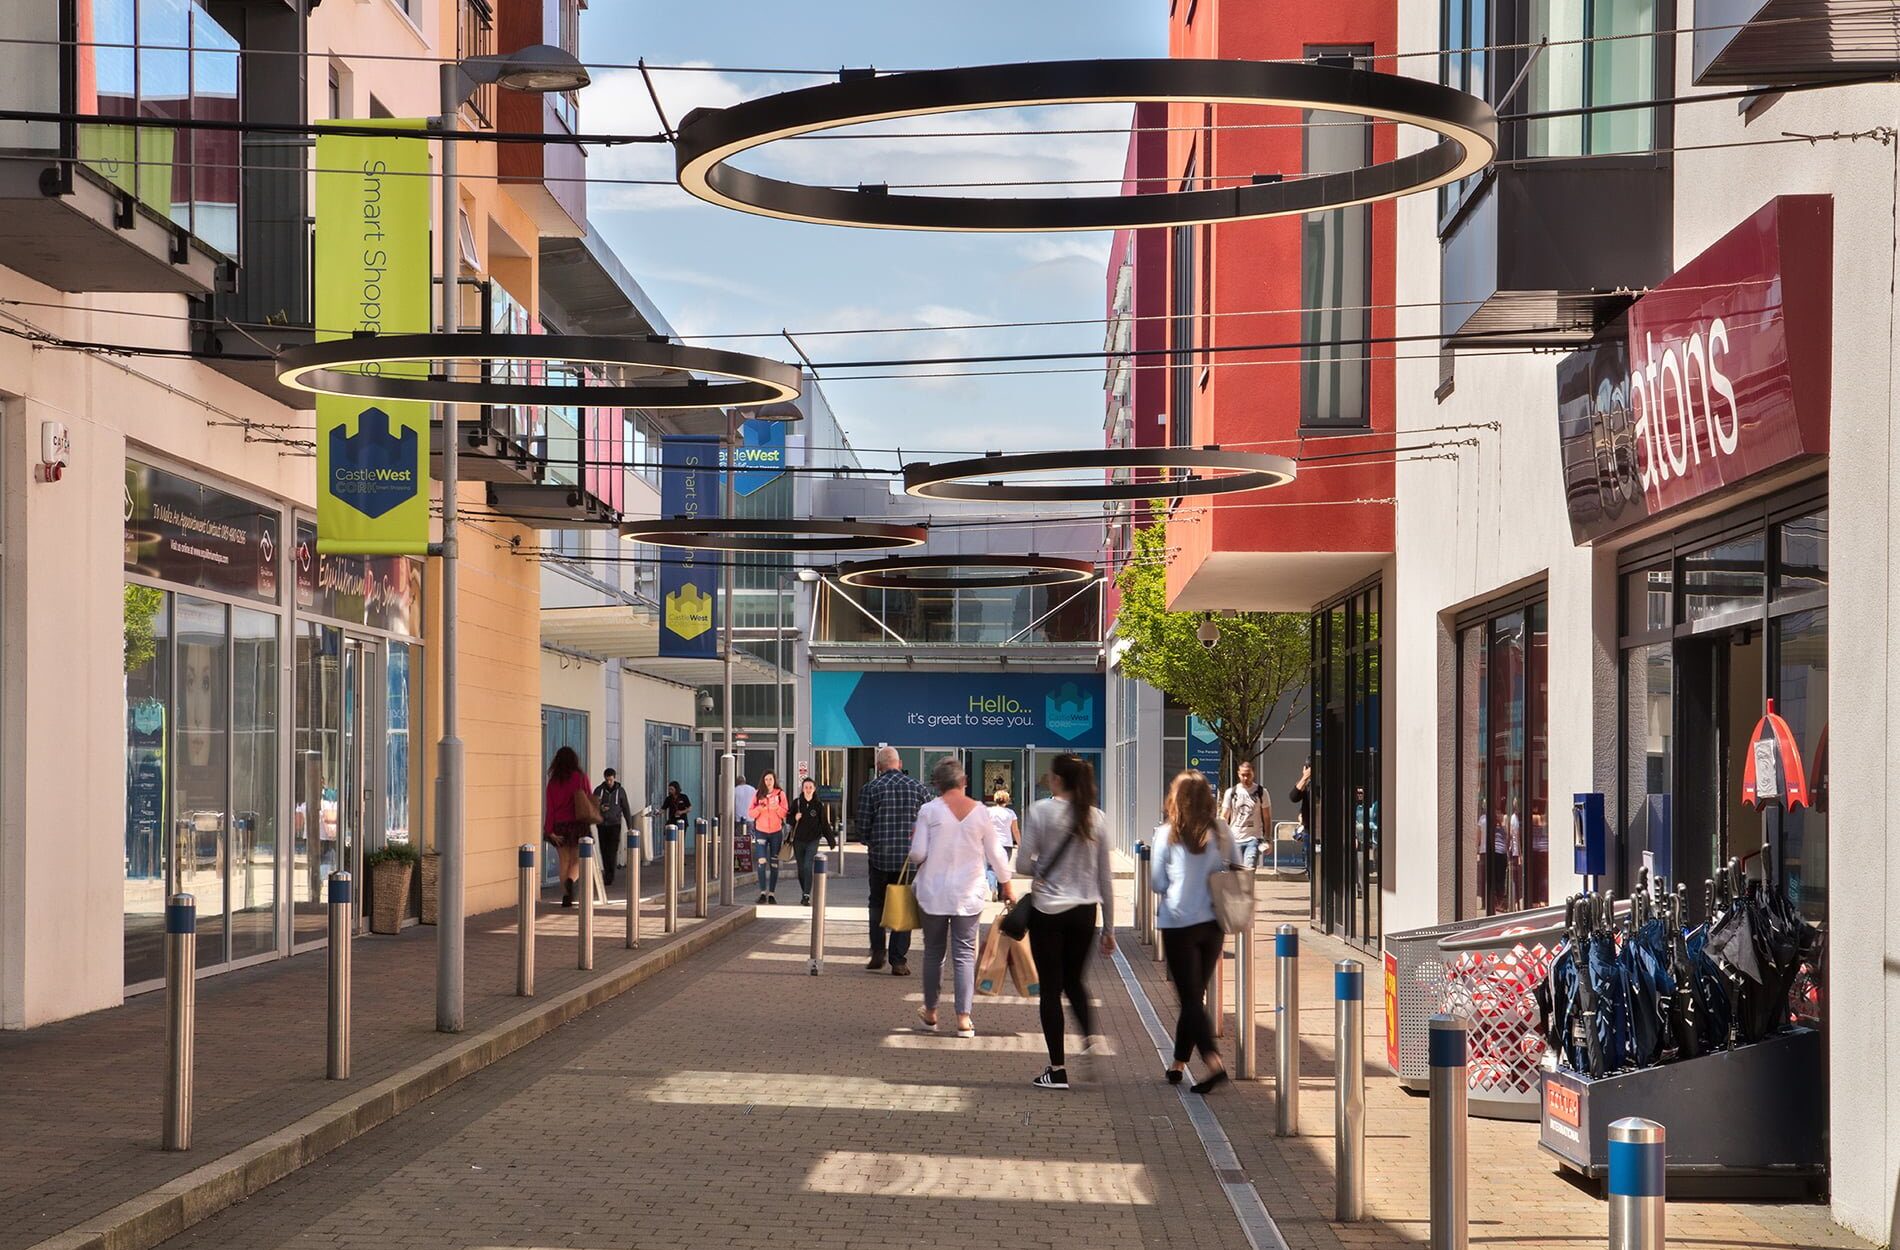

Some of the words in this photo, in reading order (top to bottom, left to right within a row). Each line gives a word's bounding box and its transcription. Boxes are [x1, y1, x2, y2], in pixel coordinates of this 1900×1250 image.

[363, 160, 386, 242] Smart
[360, 250, 387, 378] Shoppg
[335, 468, 412, 481] CastleWest
[335, 481, 377, 494] CORK
[319, 554, 365, 599] Equilibrium
[969, 695, 1032, 713] Hello...
[907, 712, 925, 725] it's
[927, 713, 962, 727] great
[965, 713, 979, 726] to
[982, 715, 1004, 726] see
[1007, 715, 1034, 728] you.
